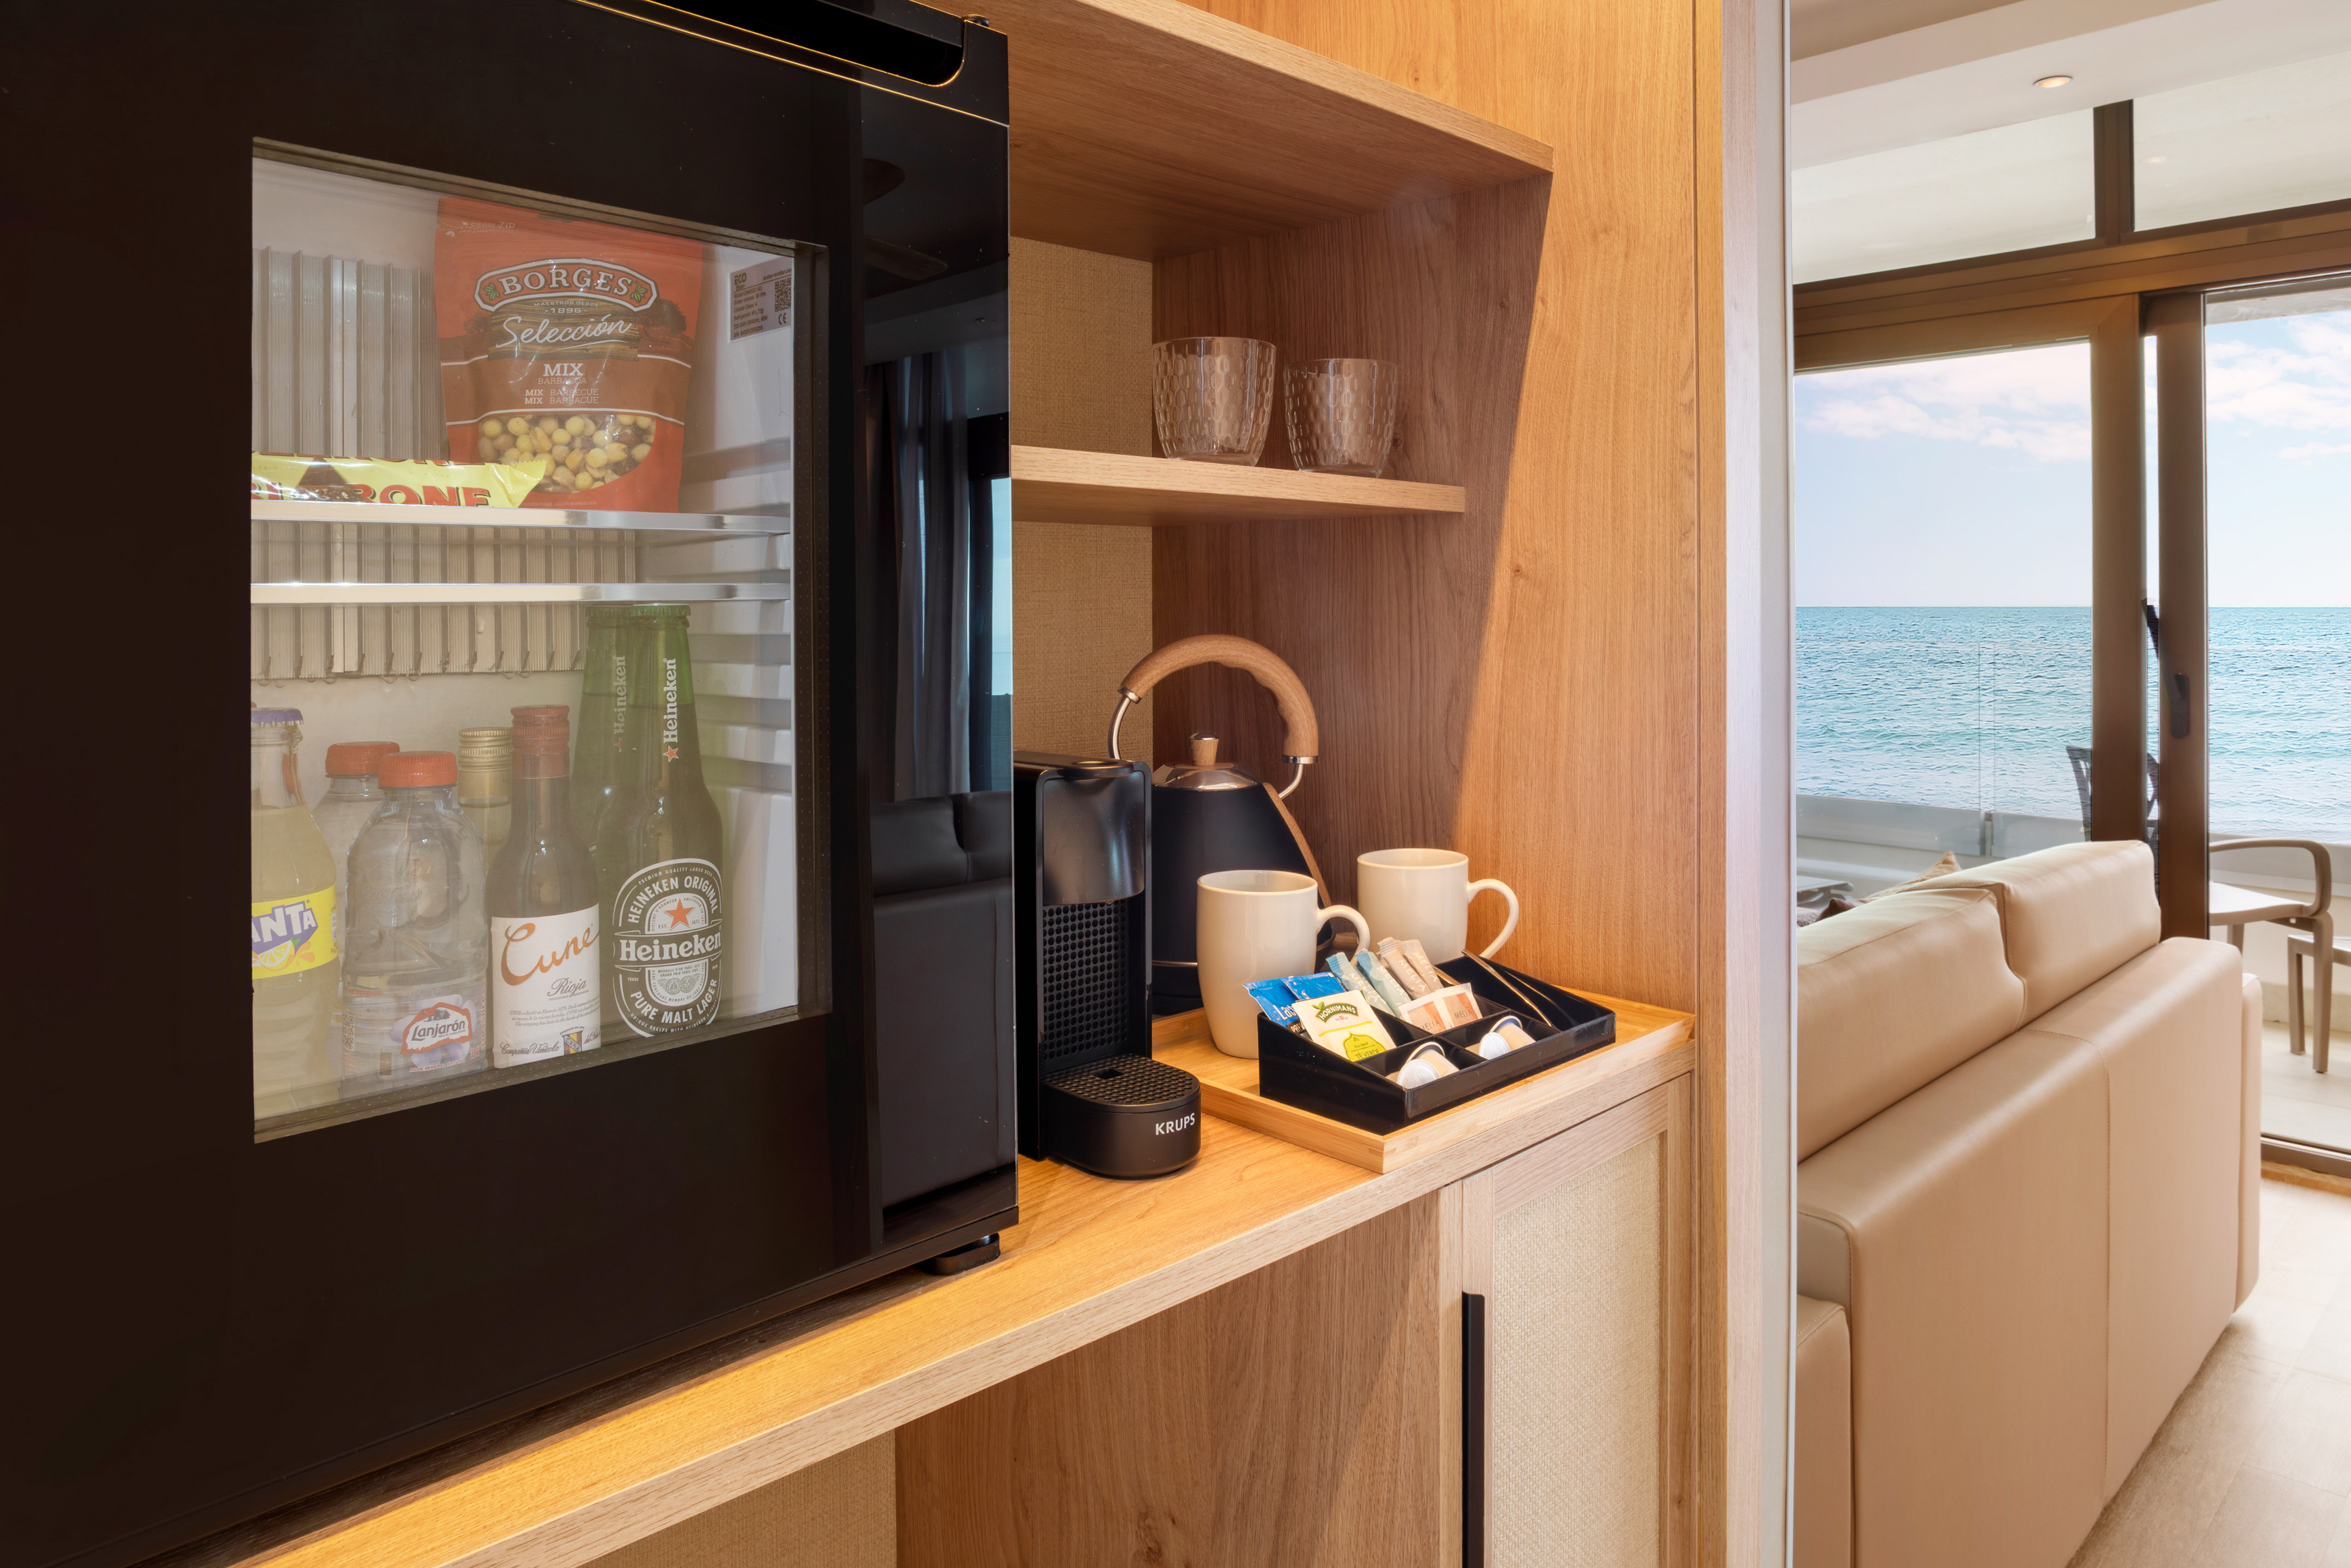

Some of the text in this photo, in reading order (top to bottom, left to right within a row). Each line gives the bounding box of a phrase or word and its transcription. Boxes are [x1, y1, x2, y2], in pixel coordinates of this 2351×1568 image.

[499, 267, 633, 296] BORGES
[495, 314, 632, 349] Selección
[543, 363, 584, 377] MIX
[613, 655, 627, 735] Heineken
[663, 658, 678, 743] Heineken
[638, 871, 663, 885] PREMIUM
[628, 876, 718, 923] HEINEKEN ORIGINAL
[501, 923, 599, 986] Cune
[619, 932, 722, 961] Heineken
[547, 976, 587, 998] Rioja
[630, 979, 717, 1024] PURE MALT LAGER
[1319, 1004, 1356, 1021] HORNIMANS
[411, 1019, 465, 1042] Lanjarón
[630, 1013, 648, 1028] UNIQUE
[500, 1041, 561, 1056] Compañía Vinícola
[1155, 1113, 1195, 1136] KRUPS
